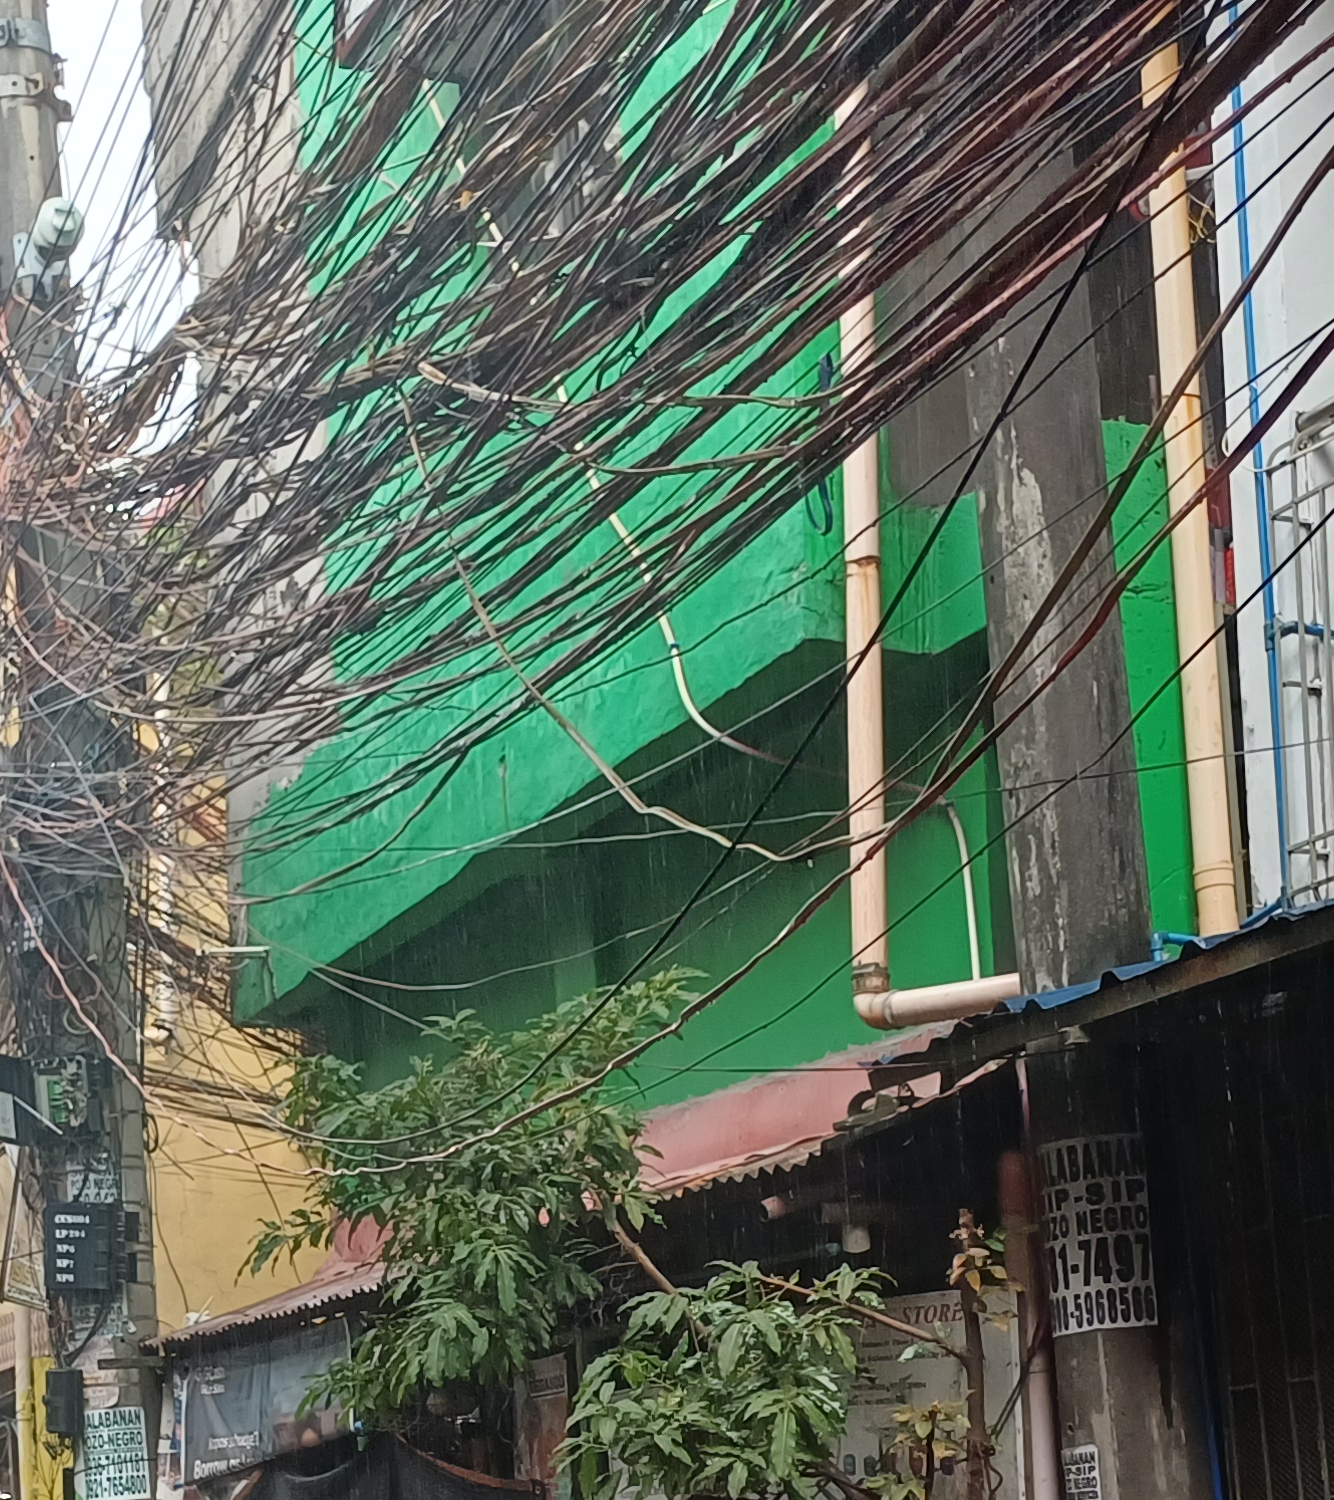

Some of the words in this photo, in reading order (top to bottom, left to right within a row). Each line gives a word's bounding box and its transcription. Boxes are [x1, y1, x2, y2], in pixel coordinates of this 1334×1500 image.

[1042, 1138, 1146, 1187] LABANAN
[1075, 1204, 1148, 1236] NEGRO
[902, 1302, 964, 1325] STORE
